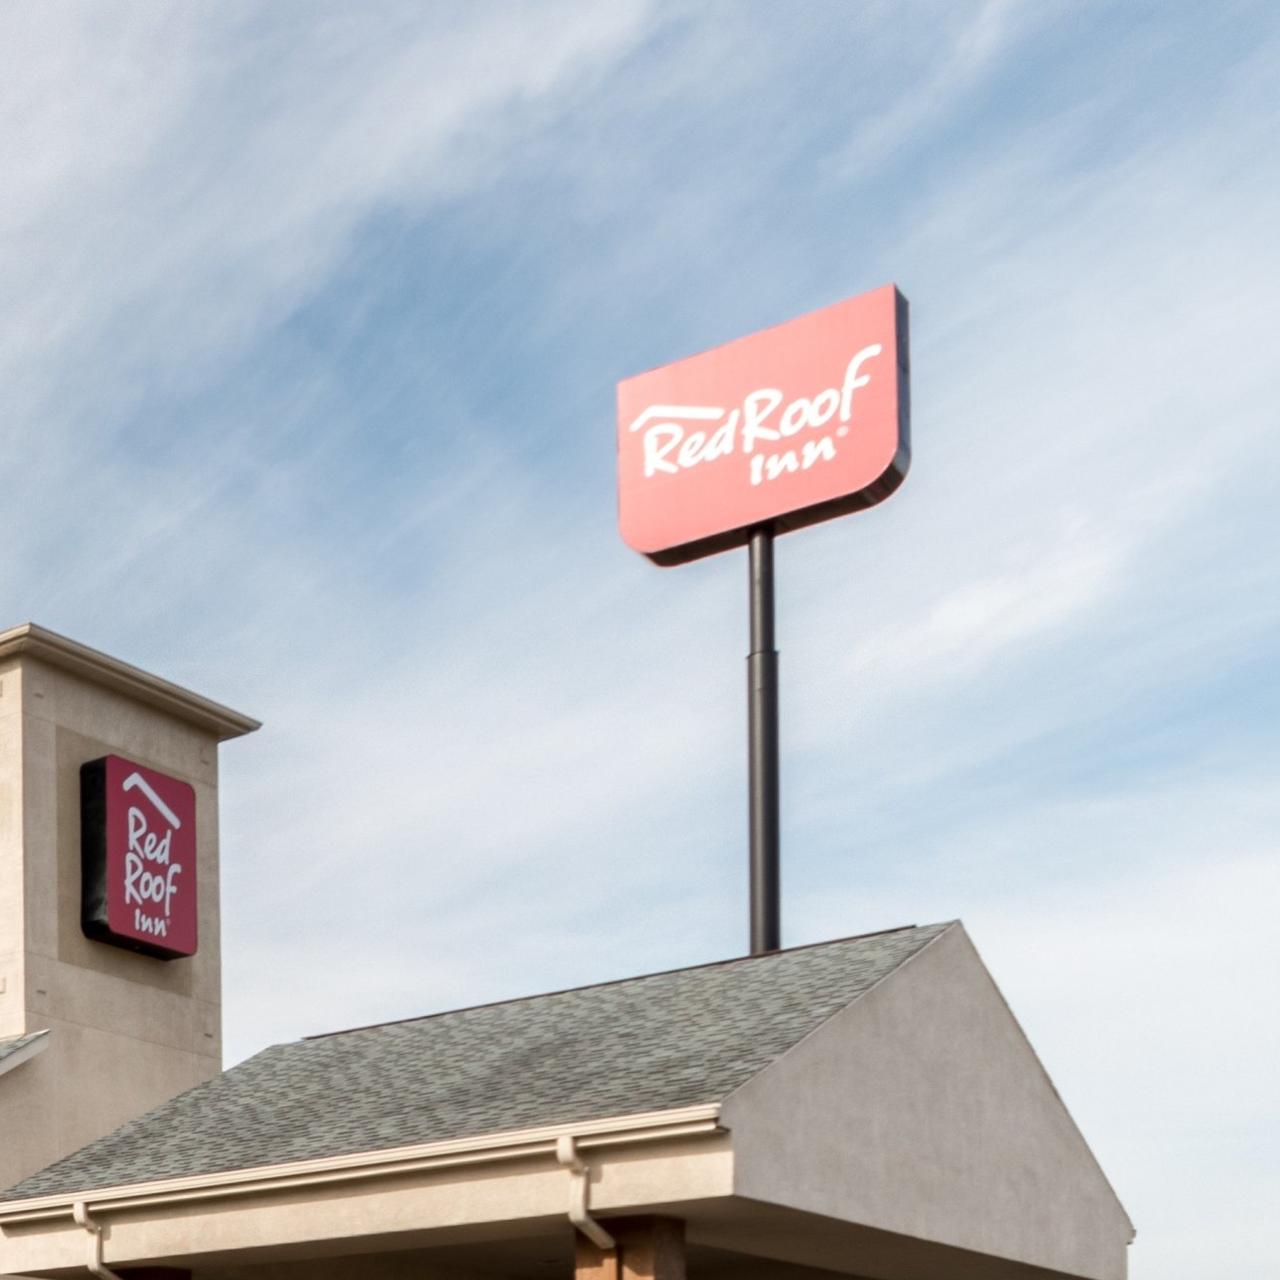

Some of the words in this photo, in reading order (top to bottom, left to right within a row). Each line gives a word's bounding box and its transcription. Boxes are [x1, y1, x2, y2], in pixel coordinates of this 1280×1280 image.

[750, 436, 836, 486] Inn
[128, 806, 172, 864] Red
[124, 853, 182, 917] Roof
[135, 908, 167, 937] Inn
